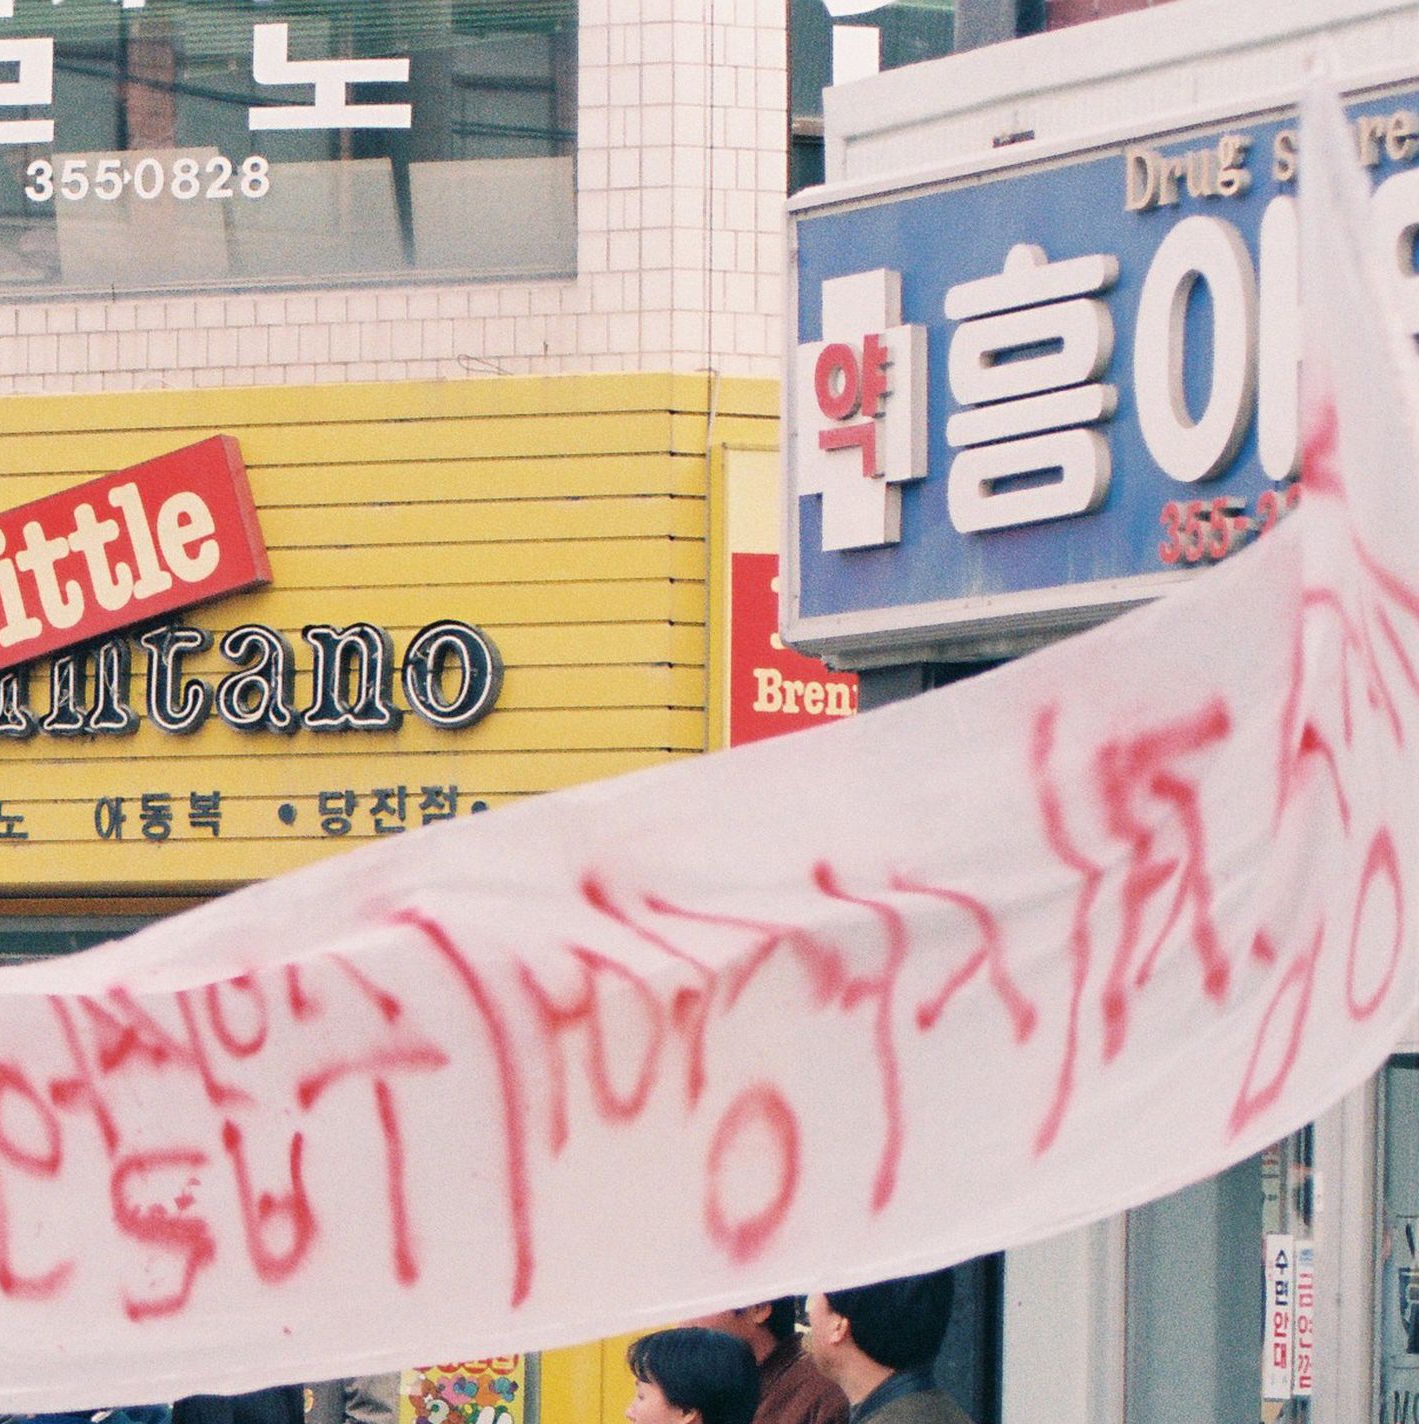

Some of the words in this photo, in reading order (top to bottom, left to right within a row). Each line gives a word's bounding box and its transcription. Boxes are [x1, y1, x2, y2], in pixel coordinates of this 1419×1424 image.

[1125, 134, 1251, 212] Drug
[1273, 110, 1419, 182] Sre
[814, 334, 896, 478] 약
[753, 668, 858, 717] Bren
[94, 790, 222, 843] 아동복
